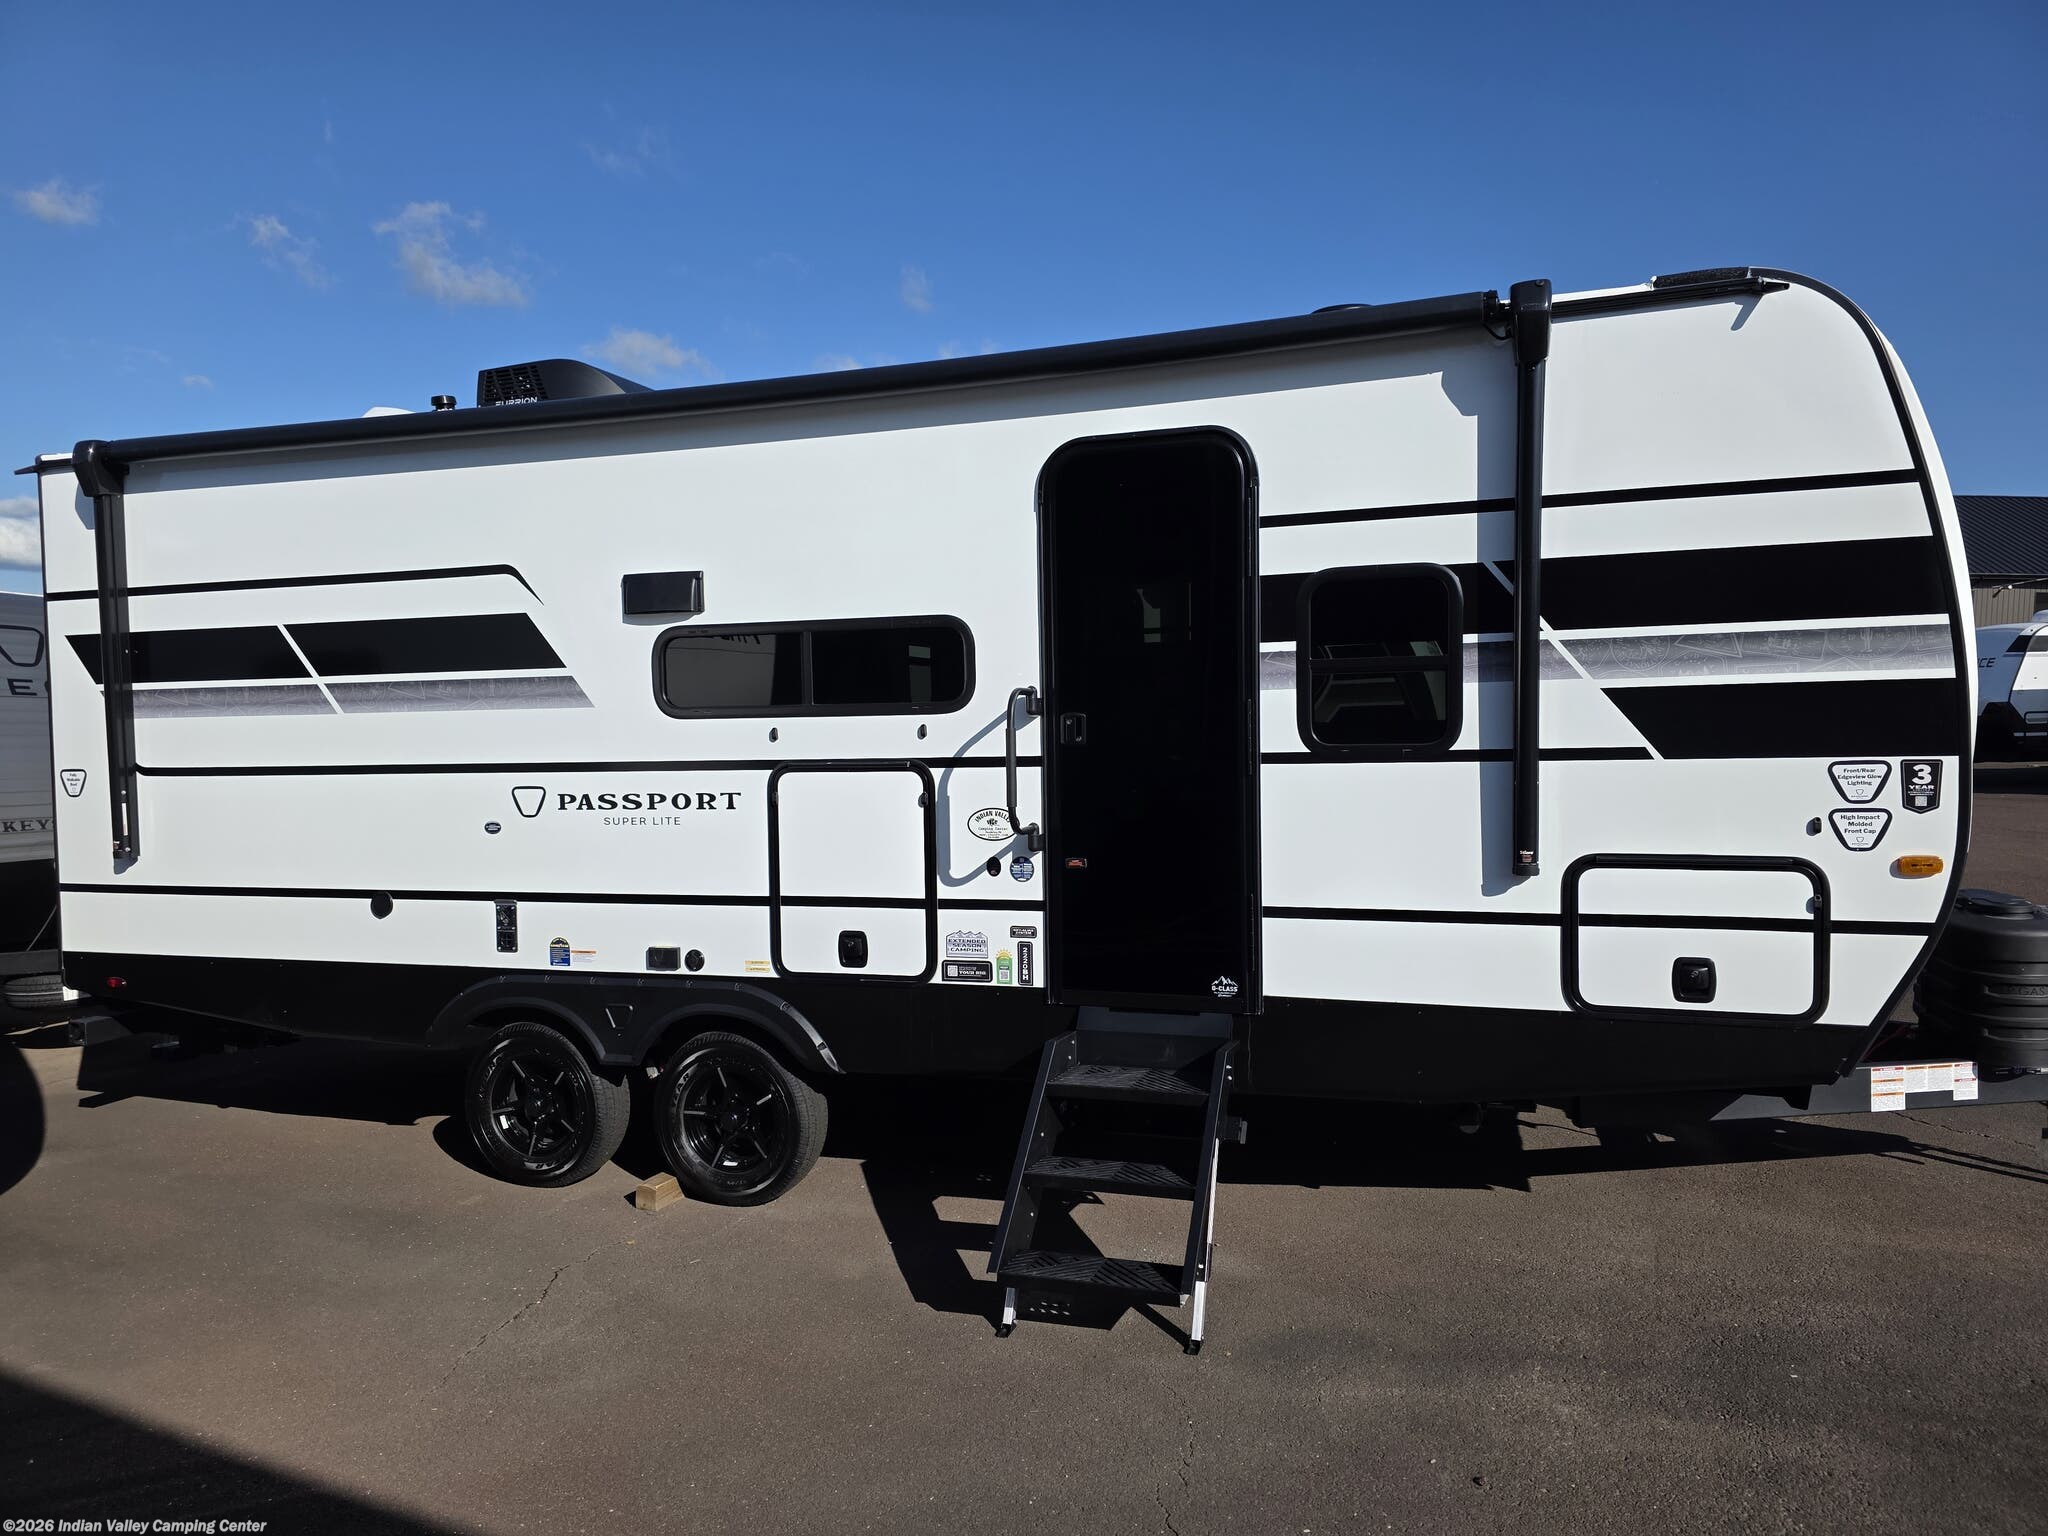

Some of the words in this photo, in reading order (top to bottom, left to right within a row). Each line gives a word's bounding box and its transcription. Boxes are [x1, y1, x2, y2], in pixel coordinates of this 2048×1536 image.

[1911, 764, 1932, 785] 3
[557, 792, 742, 811] PASSPORT
[2, 818, 55, 832] KEY
[603, 816, 647, 826] SUPER
[652, 816, 681, 826] LITE
